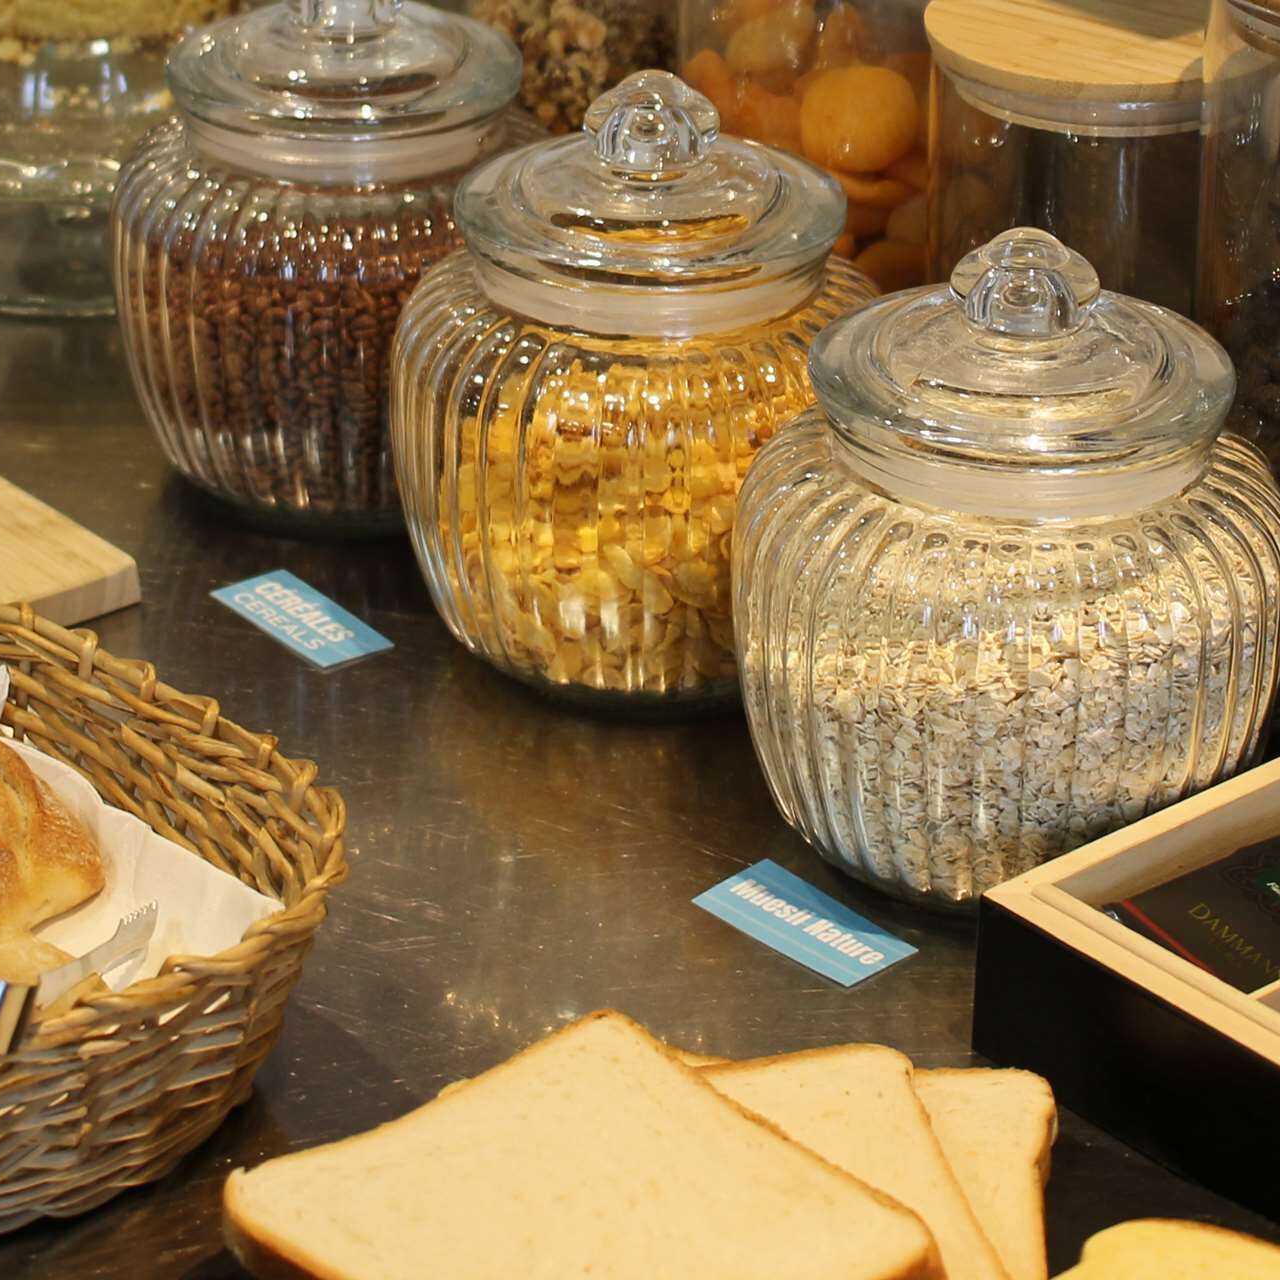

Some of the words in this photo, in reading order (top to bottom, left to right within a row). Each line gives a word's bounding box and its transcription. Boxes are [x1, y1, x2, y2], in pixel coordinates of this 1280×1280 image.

[233, 592, 326, 650] CEREALS
[255, 581, 355, 642] CÉRÉALES
[729, 878, 817, 927] Muesli
[802, 917, 886, 967] Nature
